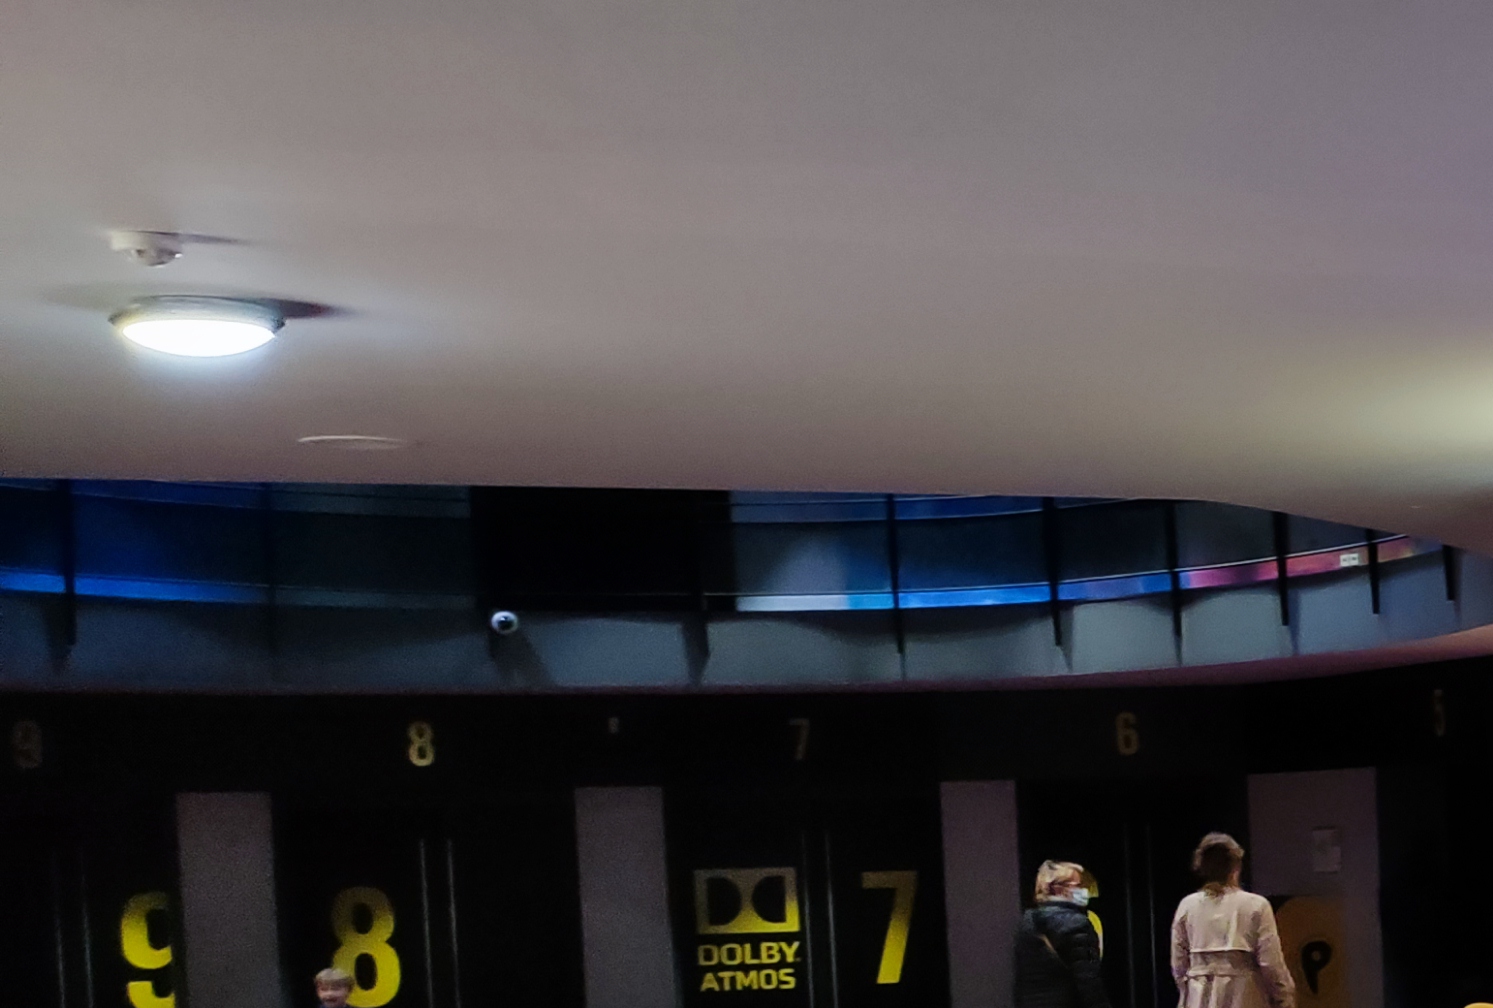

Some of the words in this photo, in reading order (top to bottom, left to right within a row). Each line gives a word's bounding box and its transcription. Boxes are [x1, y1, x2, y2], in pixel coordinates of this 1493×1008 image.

[407, 720, 436, 767] 8
[787, 718, 811, 760] 7
[1115, 711, 1141, 756] 6
[331, 887, 402, 1008] 8
[861, 870, 919, 985] 7
[698, 941, 801, 966] DOLBY
[700, 968, 796, 992] ATMOS
